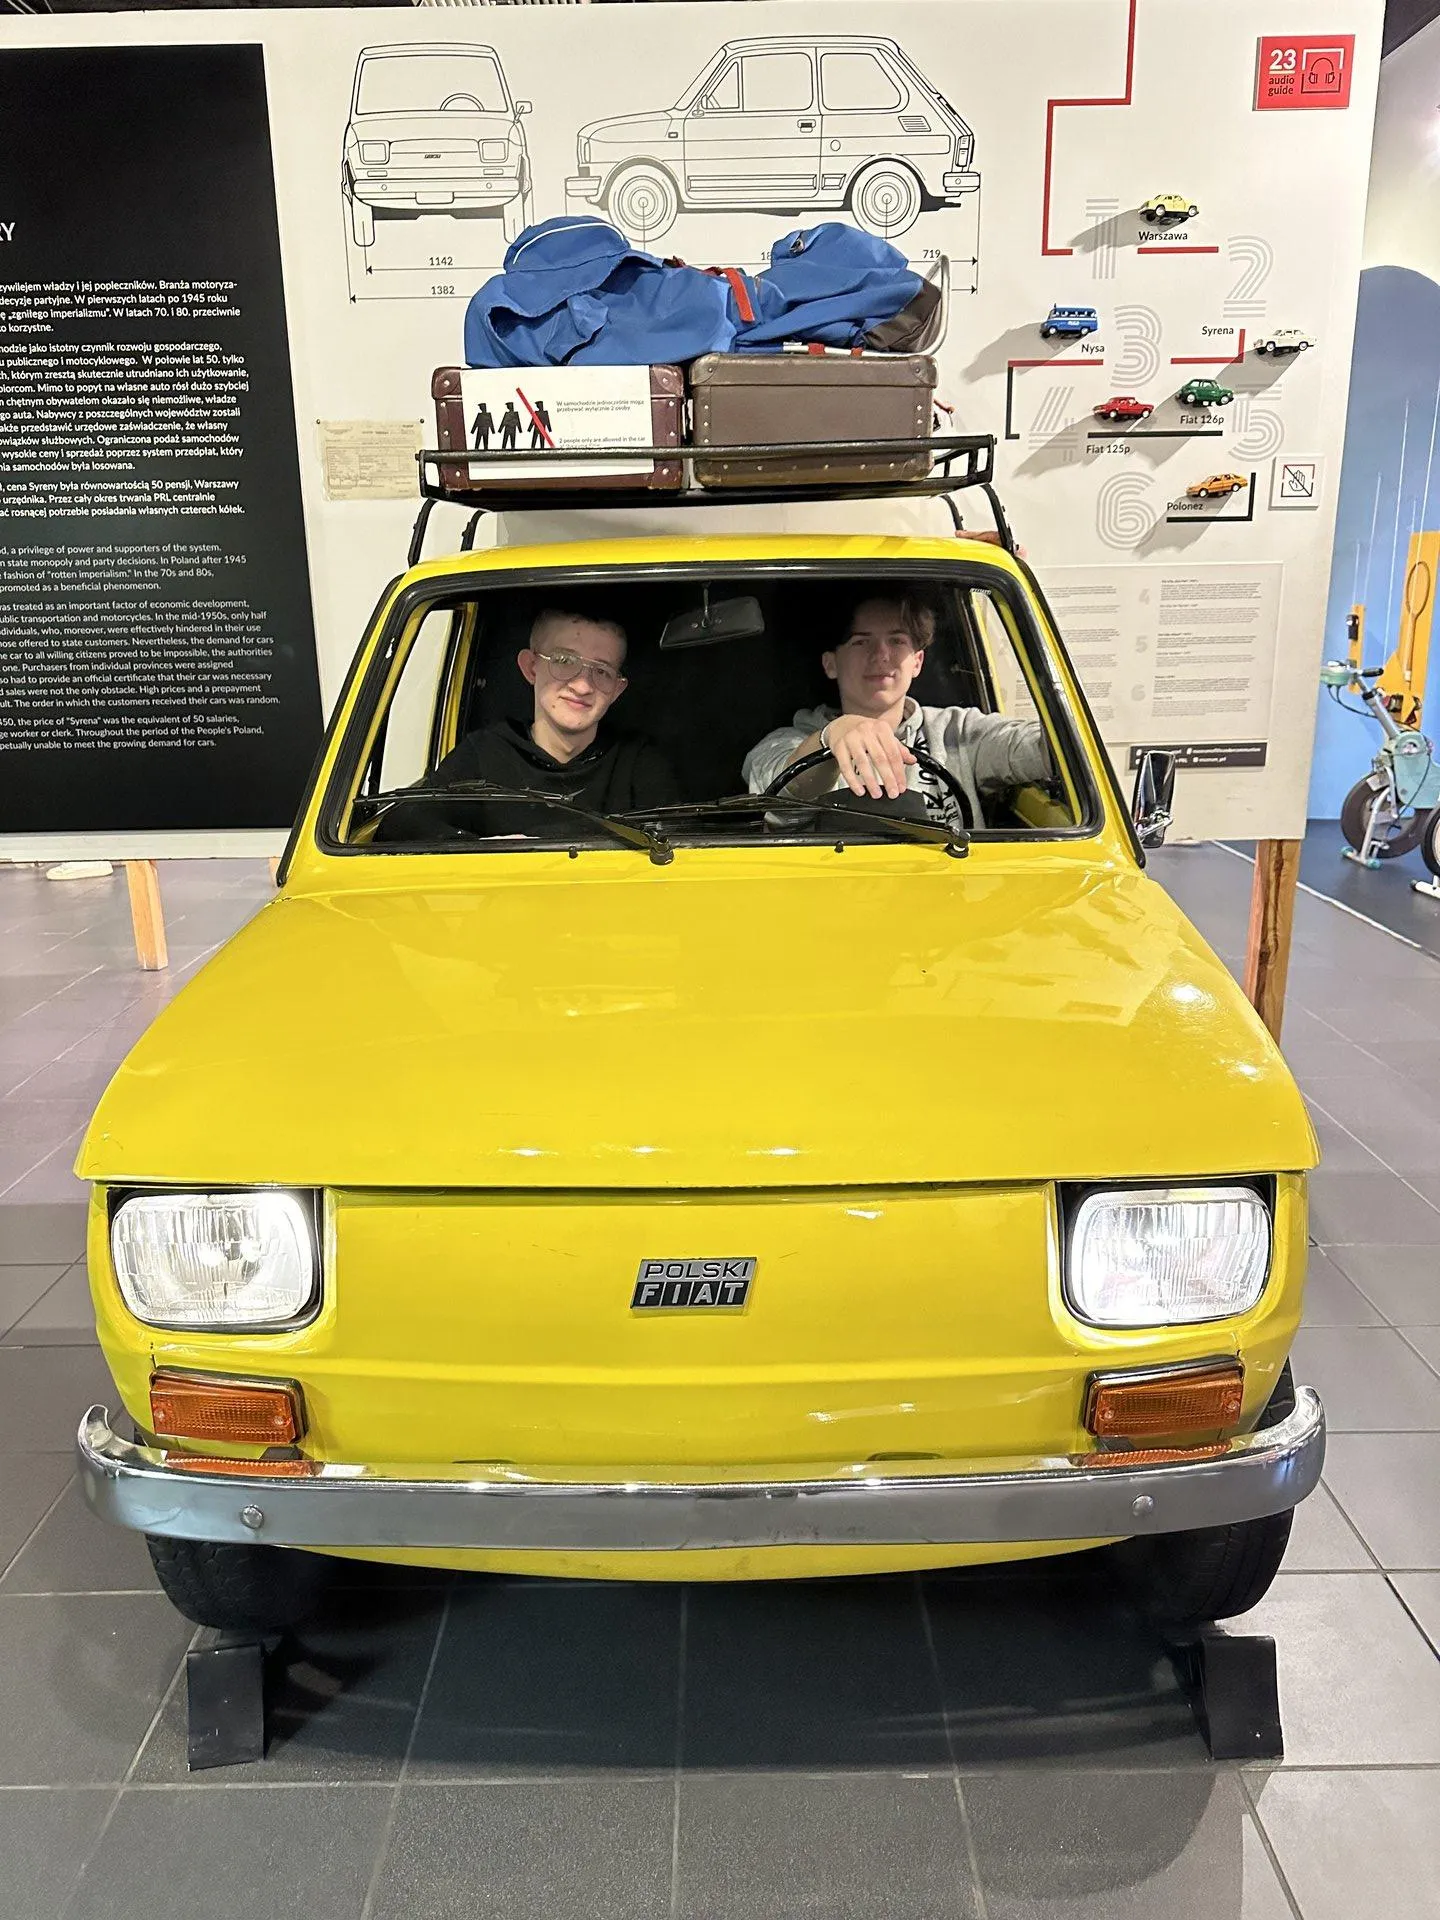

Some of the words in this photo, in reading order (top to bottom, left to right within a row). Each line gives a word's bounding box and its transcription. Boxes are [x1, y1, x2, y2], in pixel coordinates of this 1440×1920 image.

[1269, 49, 1297, 70] 23
[1268, 75, 1295, 85] audio
[1268, 86, 1294, 96] guide
[1138, 231, 1188, 241] Warszawa
[923, 249, 941, 259] 719
[429, 256, 453, 266] 1142
[431, 286, 455, 295] 1382
[1202, 326, 1234, 338] Syrena
[1081, 344, 1105, 355] Nysa
[1180, 415, 1199, 425] Fiat
[1201, 415, 1224, 427] 126p
[1086, 444, 1104, 454] Fiat
[1106, 444, 1130, 456] 125p
[1167, 501, 1203, 511] Polonez
[17, 545, 55, 557] privilege
[55, 545, 65, 554] of
[66, 545, 95, 555] power
[96, 544, 113, 553] and
[113, 544, 160, 556] supporters
[161, 543, 171, 552] of
[172, 543, 188, 552] the
[6, 559, 29, 567] state
[30, 557, 73, 569] monopoly
[74, 557, 91, 566] and
[92, 557, 116, 568] party
[160, 556, 169, 564] In
[170, 555, 200, 565] Poland
[201, 555, 222, 564] after
[224, 554, 247, 564] 1945
[41, 584, 52, 592] as
[60, 581, 102, 591] beneficial
[33, 740, 62, 749] unable
[96, 740, 111, 748] the
[112, 739, 147, 749] growing
[147, 738, 182, 747] demand
[183, 738, 196, 746] for
[645, 1262, 749, 1278] POLSKI
[640, 1282, 744, 1304] FIAT
